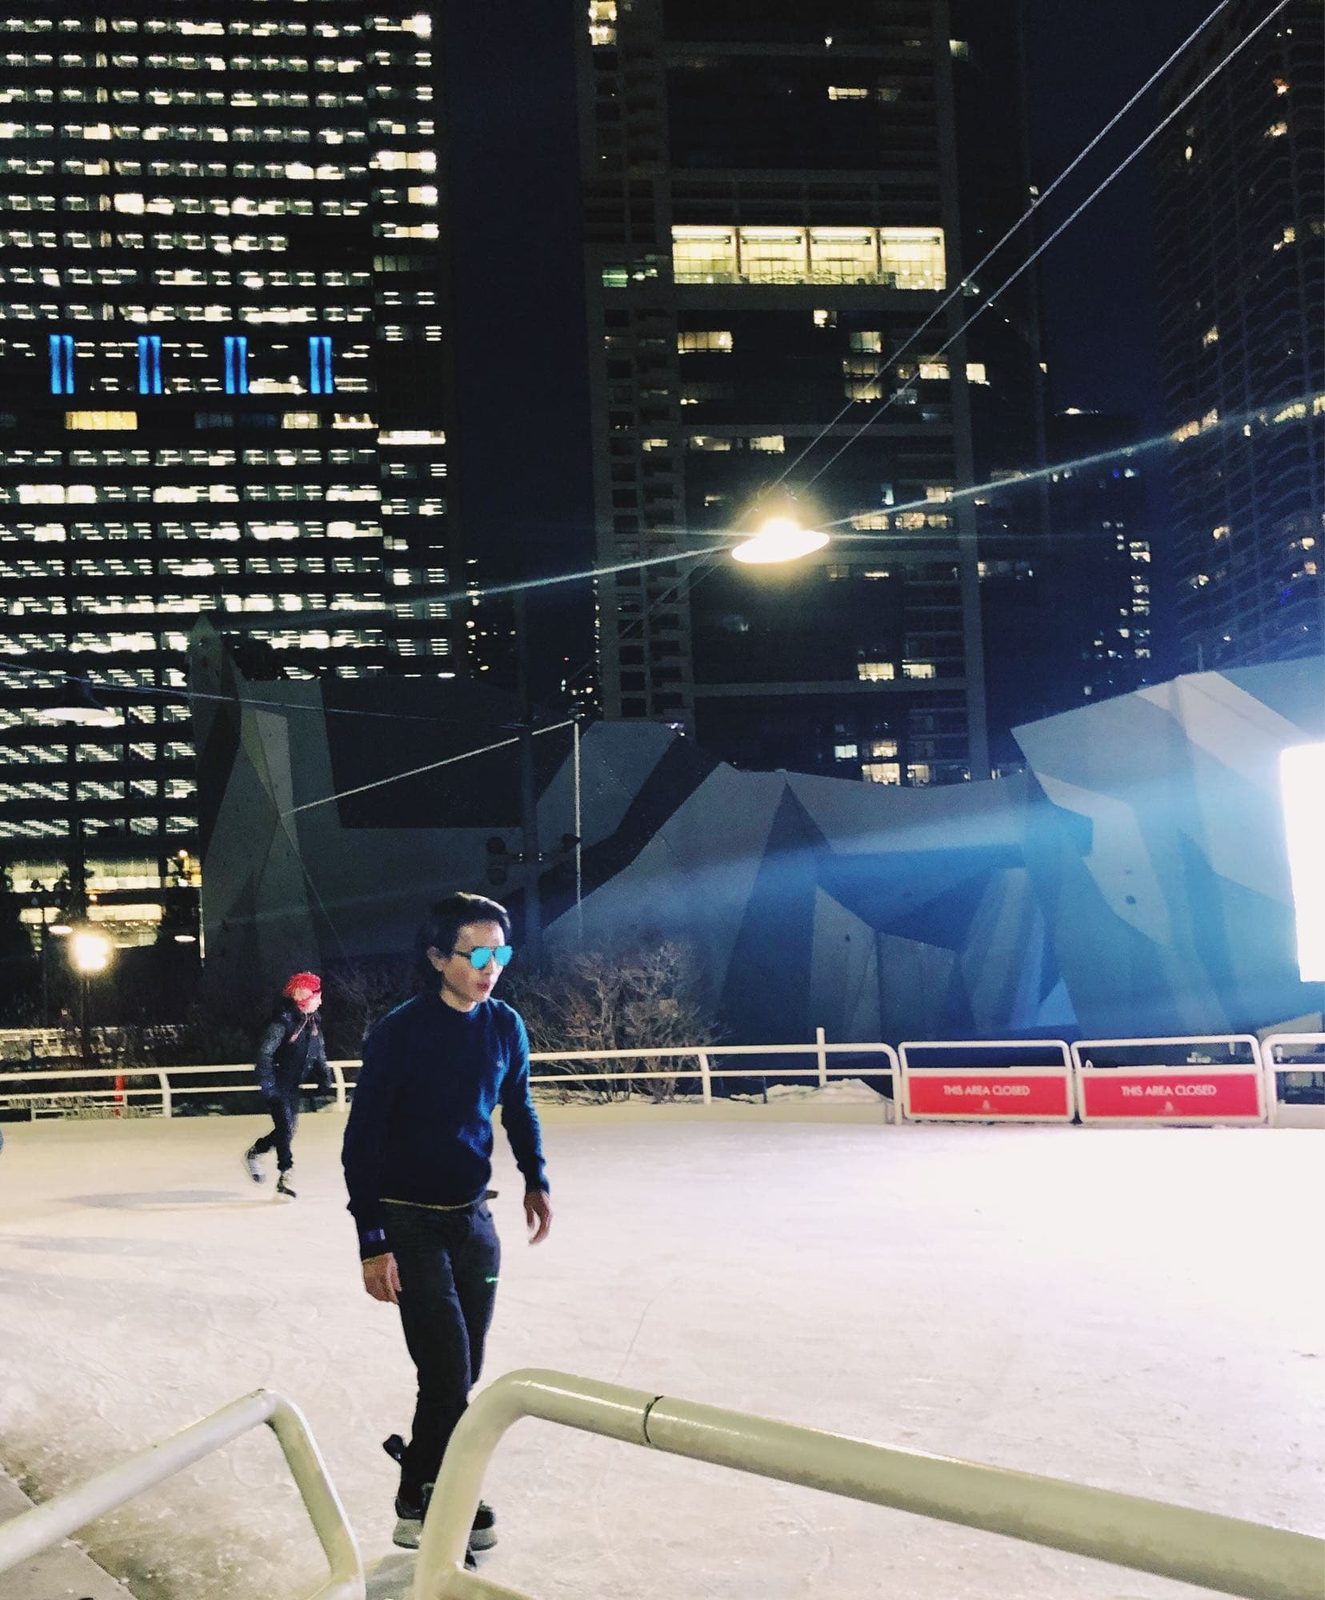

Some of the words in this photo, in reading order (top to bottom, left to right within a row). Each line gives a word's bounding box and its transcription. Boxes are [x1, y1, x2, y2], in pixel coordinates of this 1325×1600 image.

[943, 1085, 963, 1096] THIS
[965, 1085, 990, 1096] AREA
[992, 1085, 1031, 1096] CLOSED
[1121, 1085, 1143, 1096] THIS
[1145, 1085, 1173, 1096] AREA
[1174, 1084, 1217, 1096] CLOSED
